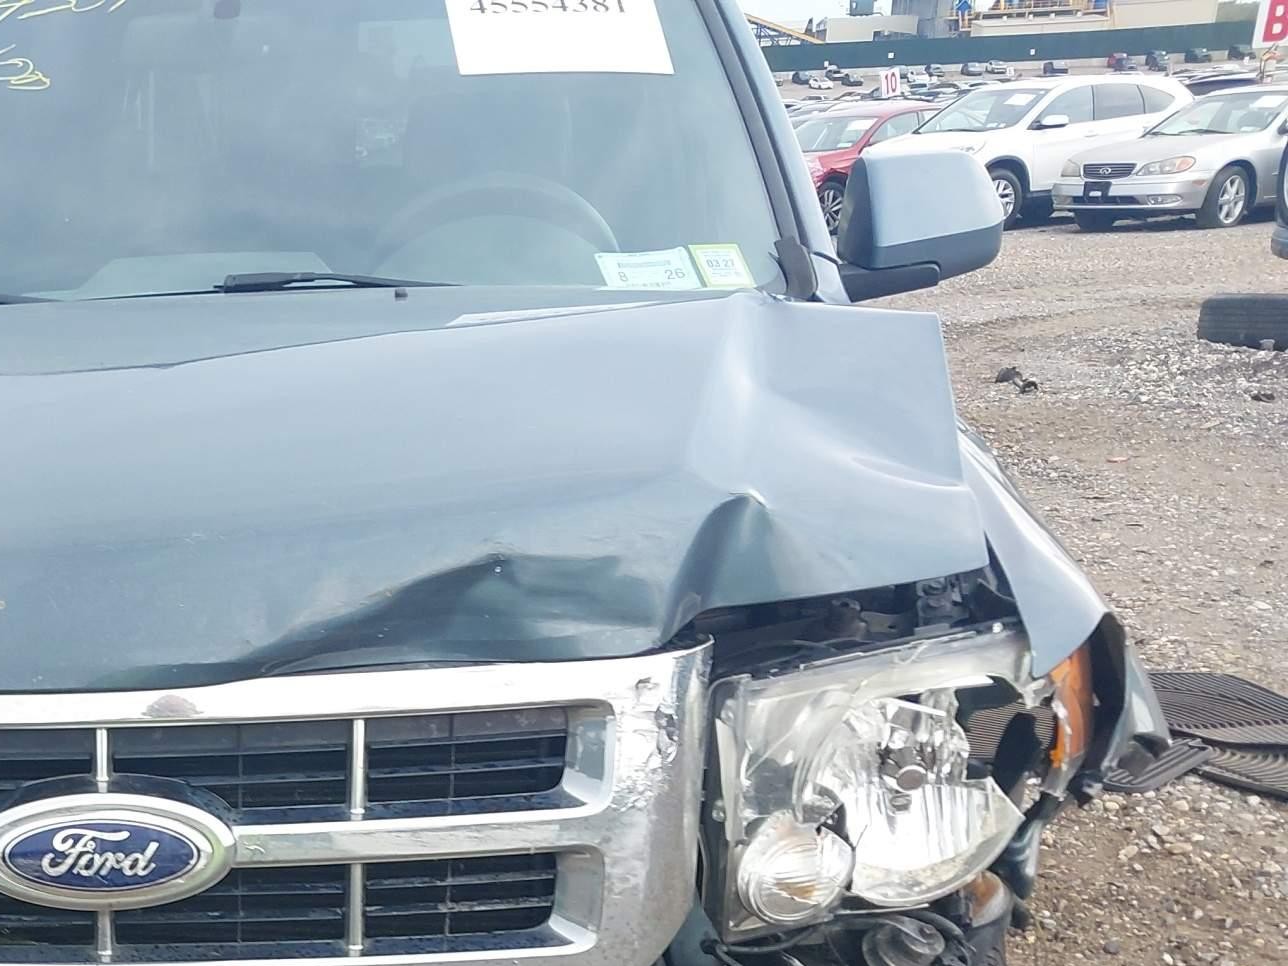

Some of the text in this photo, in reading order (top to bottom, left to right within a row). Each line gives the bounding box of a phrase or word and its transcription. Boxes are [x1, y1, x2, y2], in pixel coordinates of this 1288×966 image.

[884, 71, 897, 94] 10
[664, 268, 686, 280] 26
[40, 828, 160, 877] Ford
